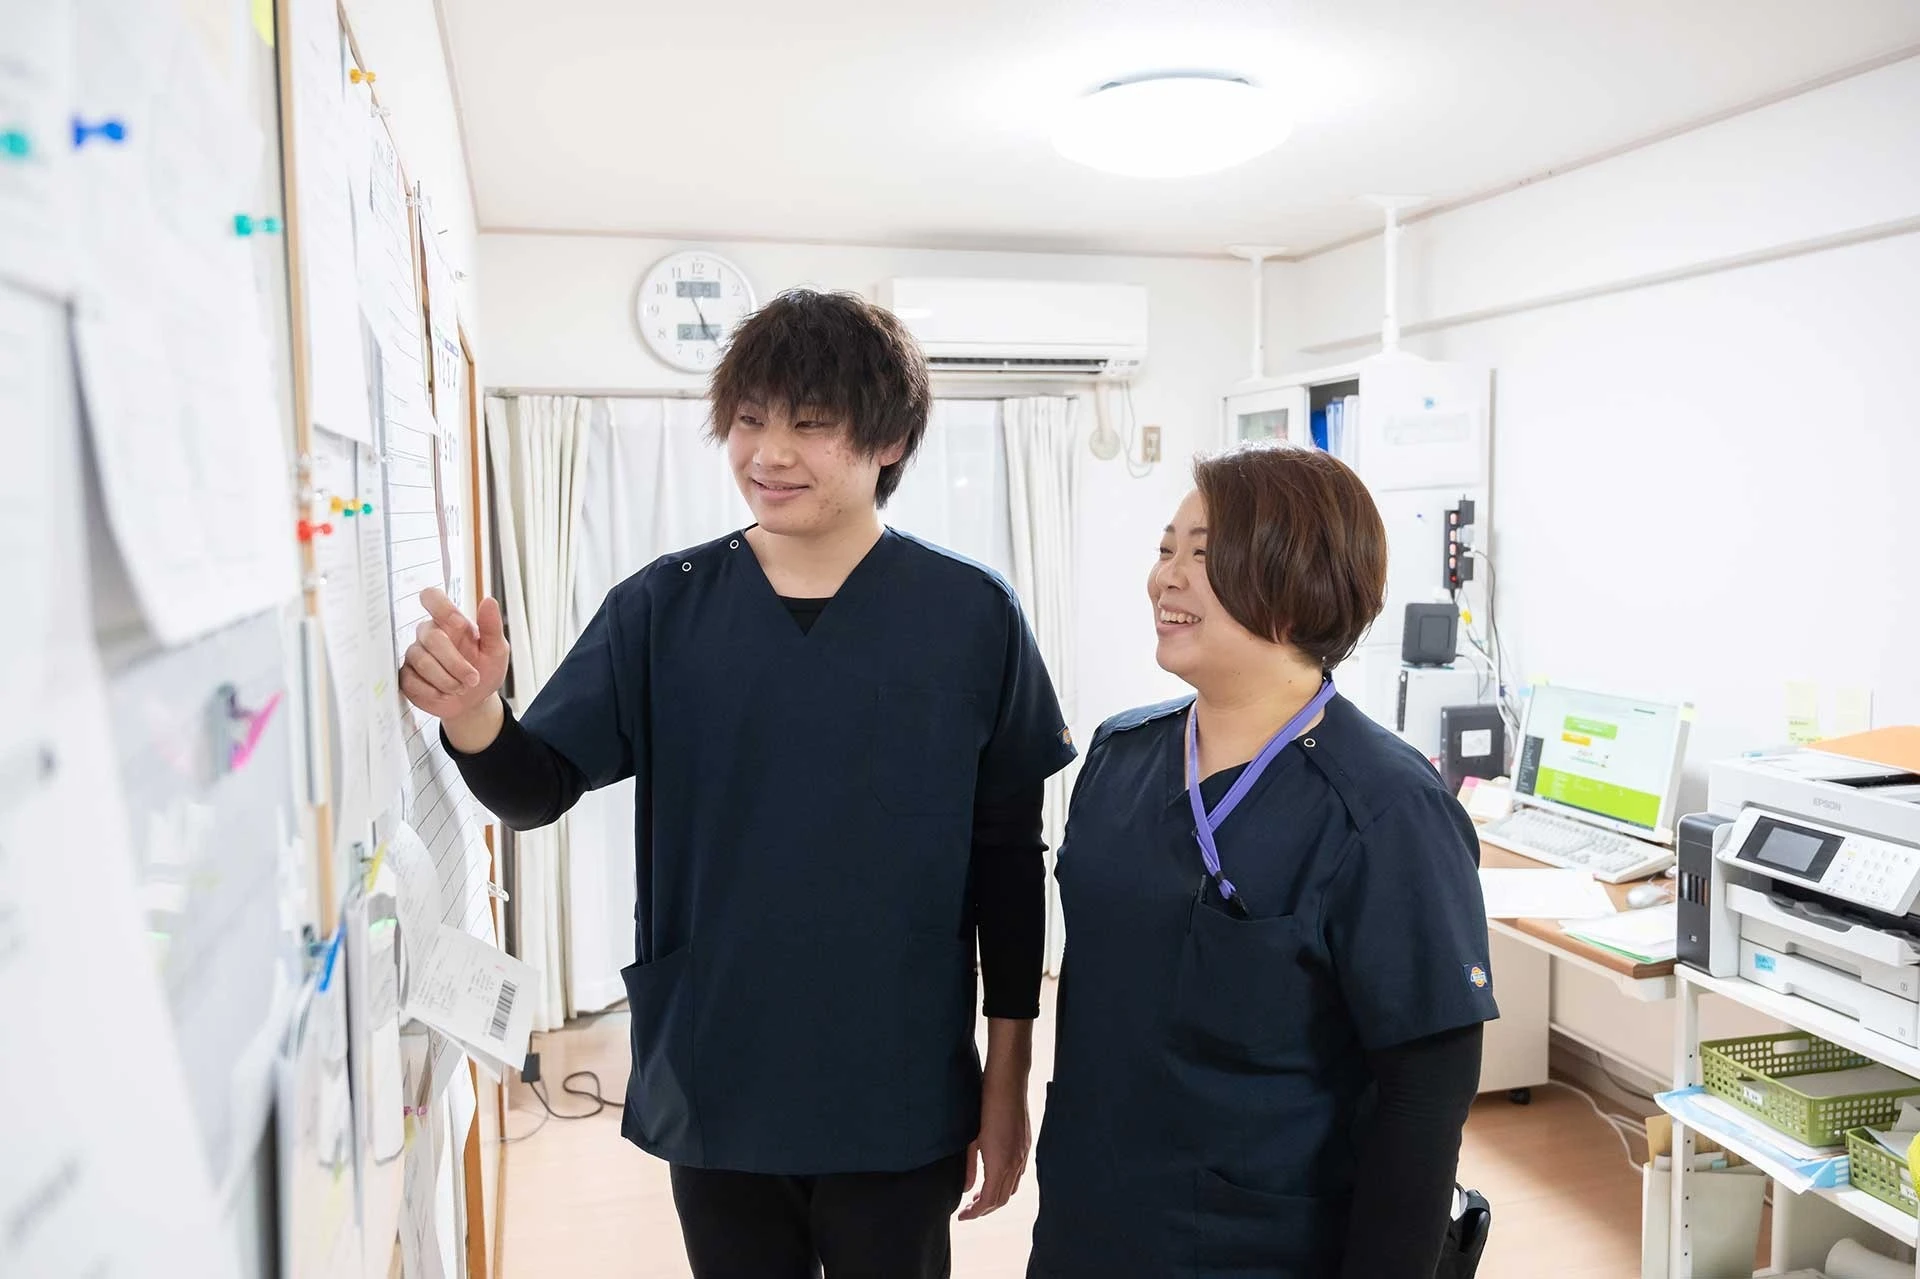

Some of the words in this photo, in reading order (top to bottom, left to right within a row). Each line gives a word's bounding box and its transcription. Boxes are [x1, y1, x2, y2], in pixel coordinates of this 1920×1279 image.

[671, 267, 682, 279] 11
[691, 262, 704, 275] 12
[717, 267, 722, 279] 1
[656, 283, 668, 295] 10
[733, 285, 741, 296] 2
[651, 305, 659, 316] 9
[658, 328, 666, 338] 8
[675, 343, 683, 355] 7
[697, 349, 704, 360] 6
[1813, 797, 1841, 811] EPSON
